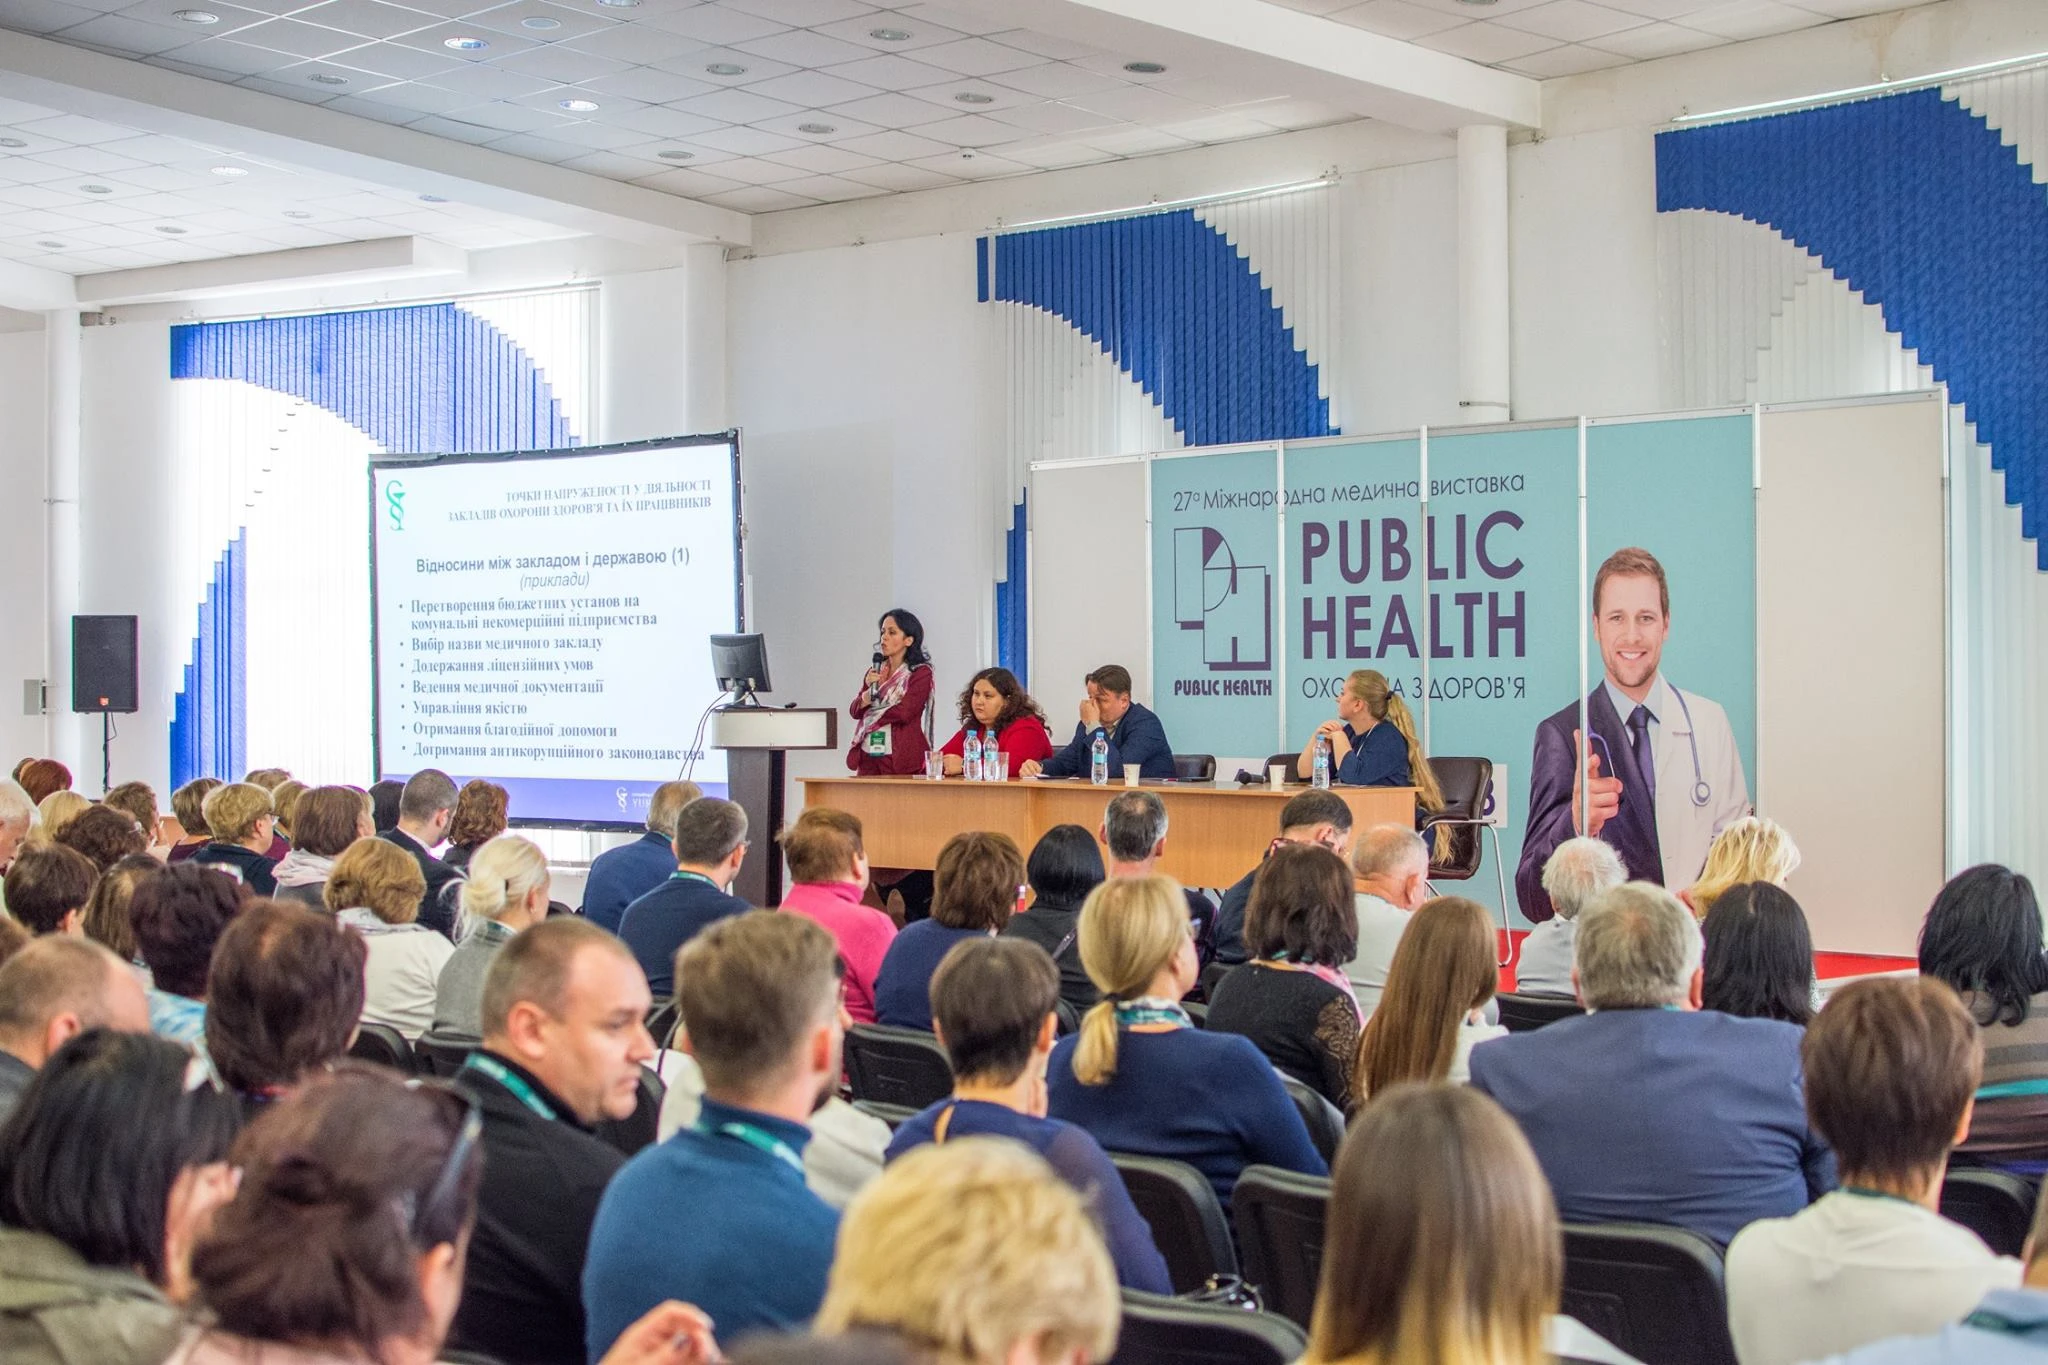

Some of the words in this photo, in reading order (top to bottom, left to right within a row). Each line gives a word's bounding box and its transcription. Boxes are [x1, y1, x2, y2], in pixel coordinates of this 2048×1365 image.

[506, 488, 541, 502] ТОЧКИ
[544, 485, 630, 500] НАПРУЖЕНОСТІ
[633, 484, 641, 495] У
[645, 479, 711, 495] ДІЯЛЬНОСТІ
[1203, 487, 1325, 511] Міжнародна
[1331, 481, 1420, 502] медична
[1430, 474, 1525, 496] виставка
[448, 508, 497, 522] ЗАКЛАДІВ
[499, 506, 550, 519] ОХОРОНИ
[607, 502, 619, 513] ТА
[622, 499, 633, 512] ЇХ
[636, 496, 712, 512] ПРАЦІВНИКІВ
[1302, 510, 1525, 585] PUBLIC
[416, 557, 484, 574] Відносини
[488, 555, 512, 571] між
[515, 556, 581, 571] закладом
[593, 553, 667, 569] державою
[672, 547, 690, 566] (1)
[519, 572, 590, 591] (приклади)
[411, 599, 496, 616] Перетворення
[498, 597, 567, 611] бюджетних
[570, 596, 620, 612] установ
[624, 595, 640, 608] на
[411, 615, 478, 634] комунальні
[482, 614, 565, 631] некомерційні
[568, 612, 658, 629] підприємства
[1302, 590, 1525, 659] HEALTH
[411, 636, 445, 652] Вибір
[447, 638, 482, 650] назви
[485, 637, 550, 650] медичного
[553, 637, 603, 652] закладу
[411, 659, 484, 674] Додержання
[487, 658, 560, 672] ліцензійних
[563, 659, 594, 674] умов
[412, 680, 461, 694] Ведення
[464, 680, 519, 694] медичної
[521, 679, 604, 696] документації
[1174, 679, 1220, 696] PUBLIC
[1223, 679, 1272, 696] HEALTH
[1302, 676, 1406, 699] ОХОА
[1411, 676, 1526, 701] ЗДОРОВ'Я
[412, 701, 482, 717] Управління
[485, 701, 528, 715] якістю
[412, 721, 482, 738] Отримання
[484, 721, 554, 738] благодійної
[557, 724, 618, 738] допомоги
[412, 742, 487, 759] Дотримання
[490, 745, 604, 761] антикорупційного
[608, 748, 705, 761] законодавства
